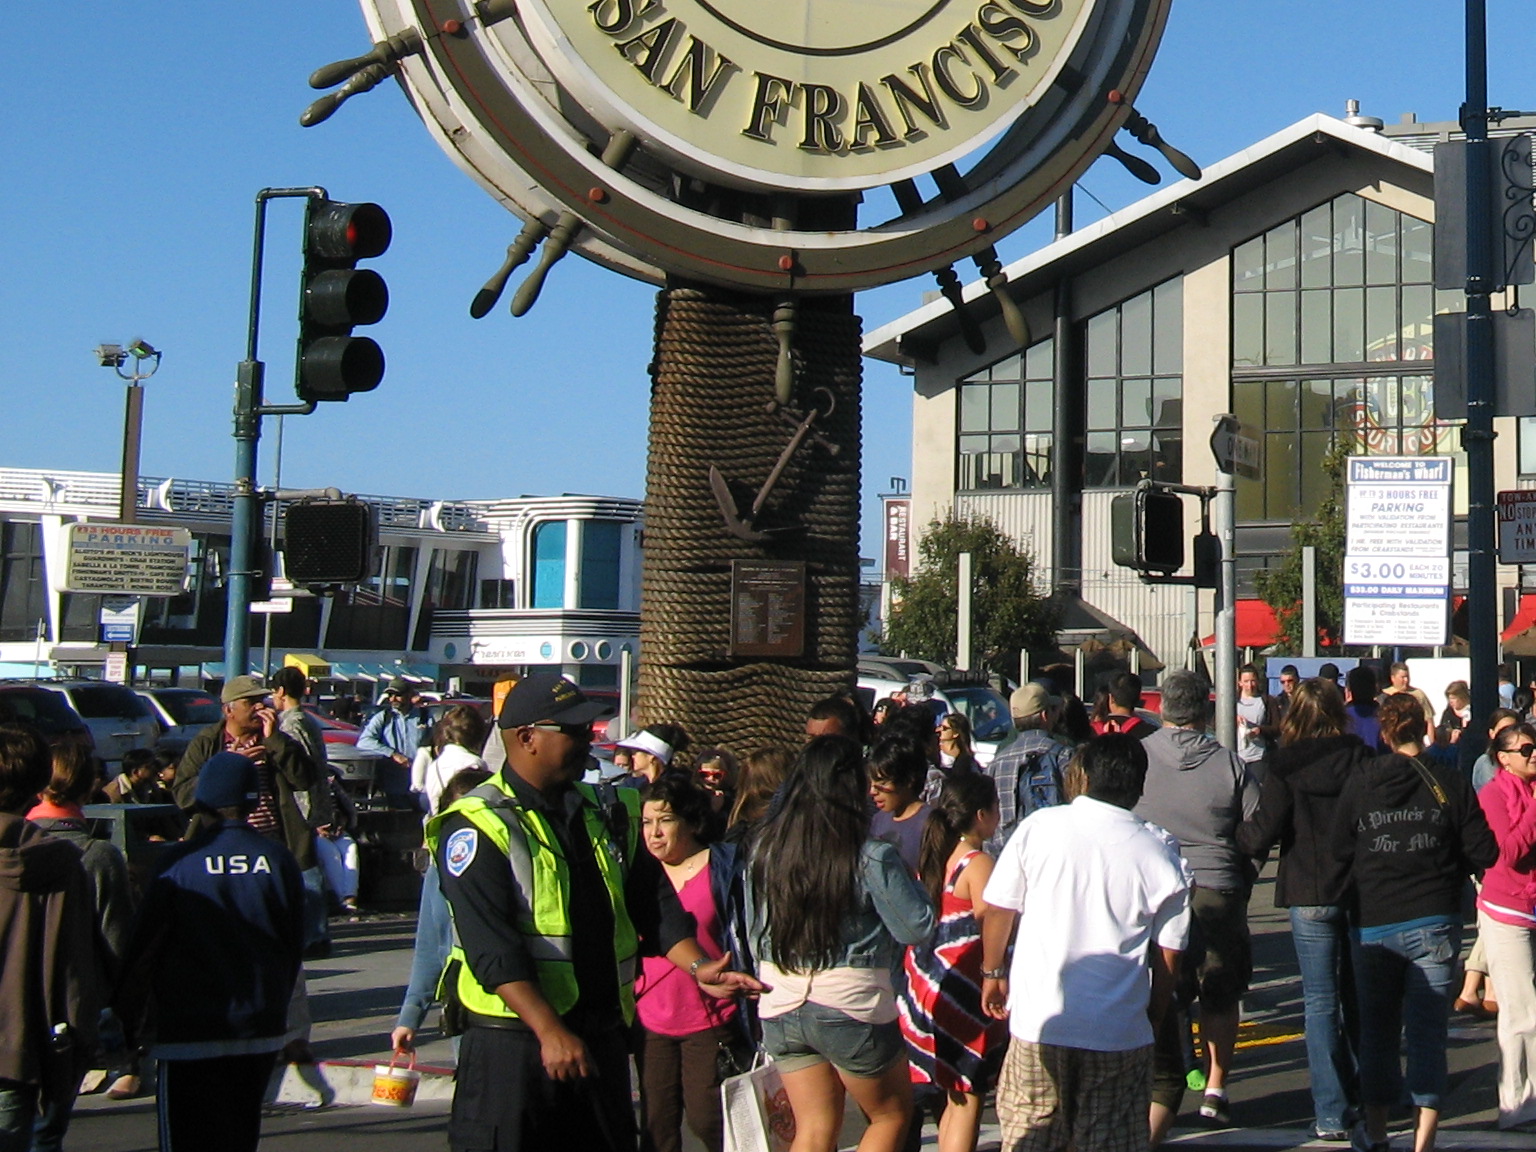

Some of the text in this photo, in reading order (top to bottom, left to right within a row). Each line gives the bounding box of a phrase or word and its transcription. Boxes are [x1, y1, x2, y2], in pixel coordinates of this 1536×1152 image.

[1355, 462, 1444, 480] Fisherman's Wharf
[1373, 461, 1412, 469] WELCOME
[1378, 490, 1384, 499] 3
[1386, 490, 1416, 499] HOURS
[1419, 490, 1438, 499] FREE
[1371, 503, 1425, 512] PARKING
[1500, 504, 1515, 520] NO
[890, 517, 898, 541] BAR
[897, 505, 907, 561] RESTAURANT
[88, 534, 174, 544] PARKING
[1351, 562, 1405, 579] $3.00
[205, 855, 272, 874] USA
